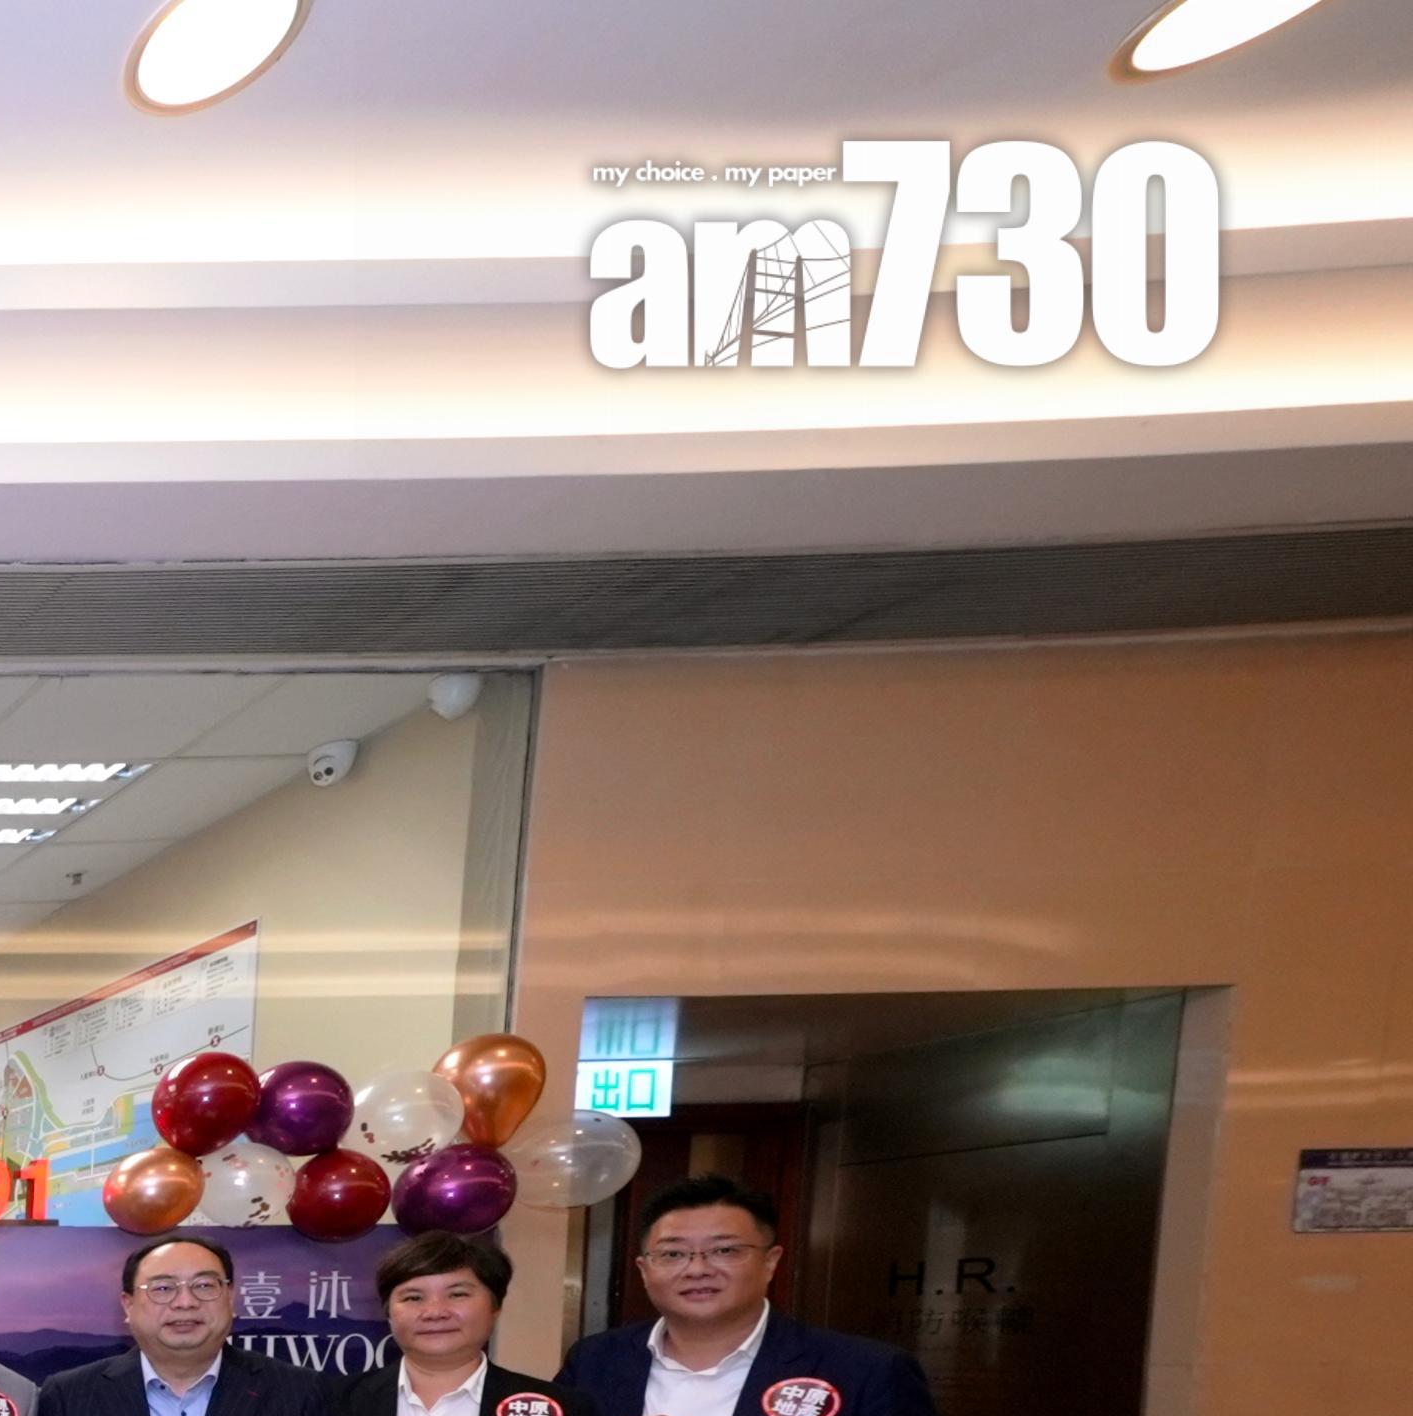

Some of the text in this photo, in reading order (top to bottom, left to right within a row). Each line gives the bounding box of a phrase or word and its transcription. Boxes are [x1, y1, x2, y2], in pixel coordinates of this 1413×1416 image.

[591, 1068, 657, 1112] 出口
[887, 1257, 1016, 1297] H.R.
[507, 1400, 550, 1415] 中原
[780, 1385, 830, 1405] 中原
